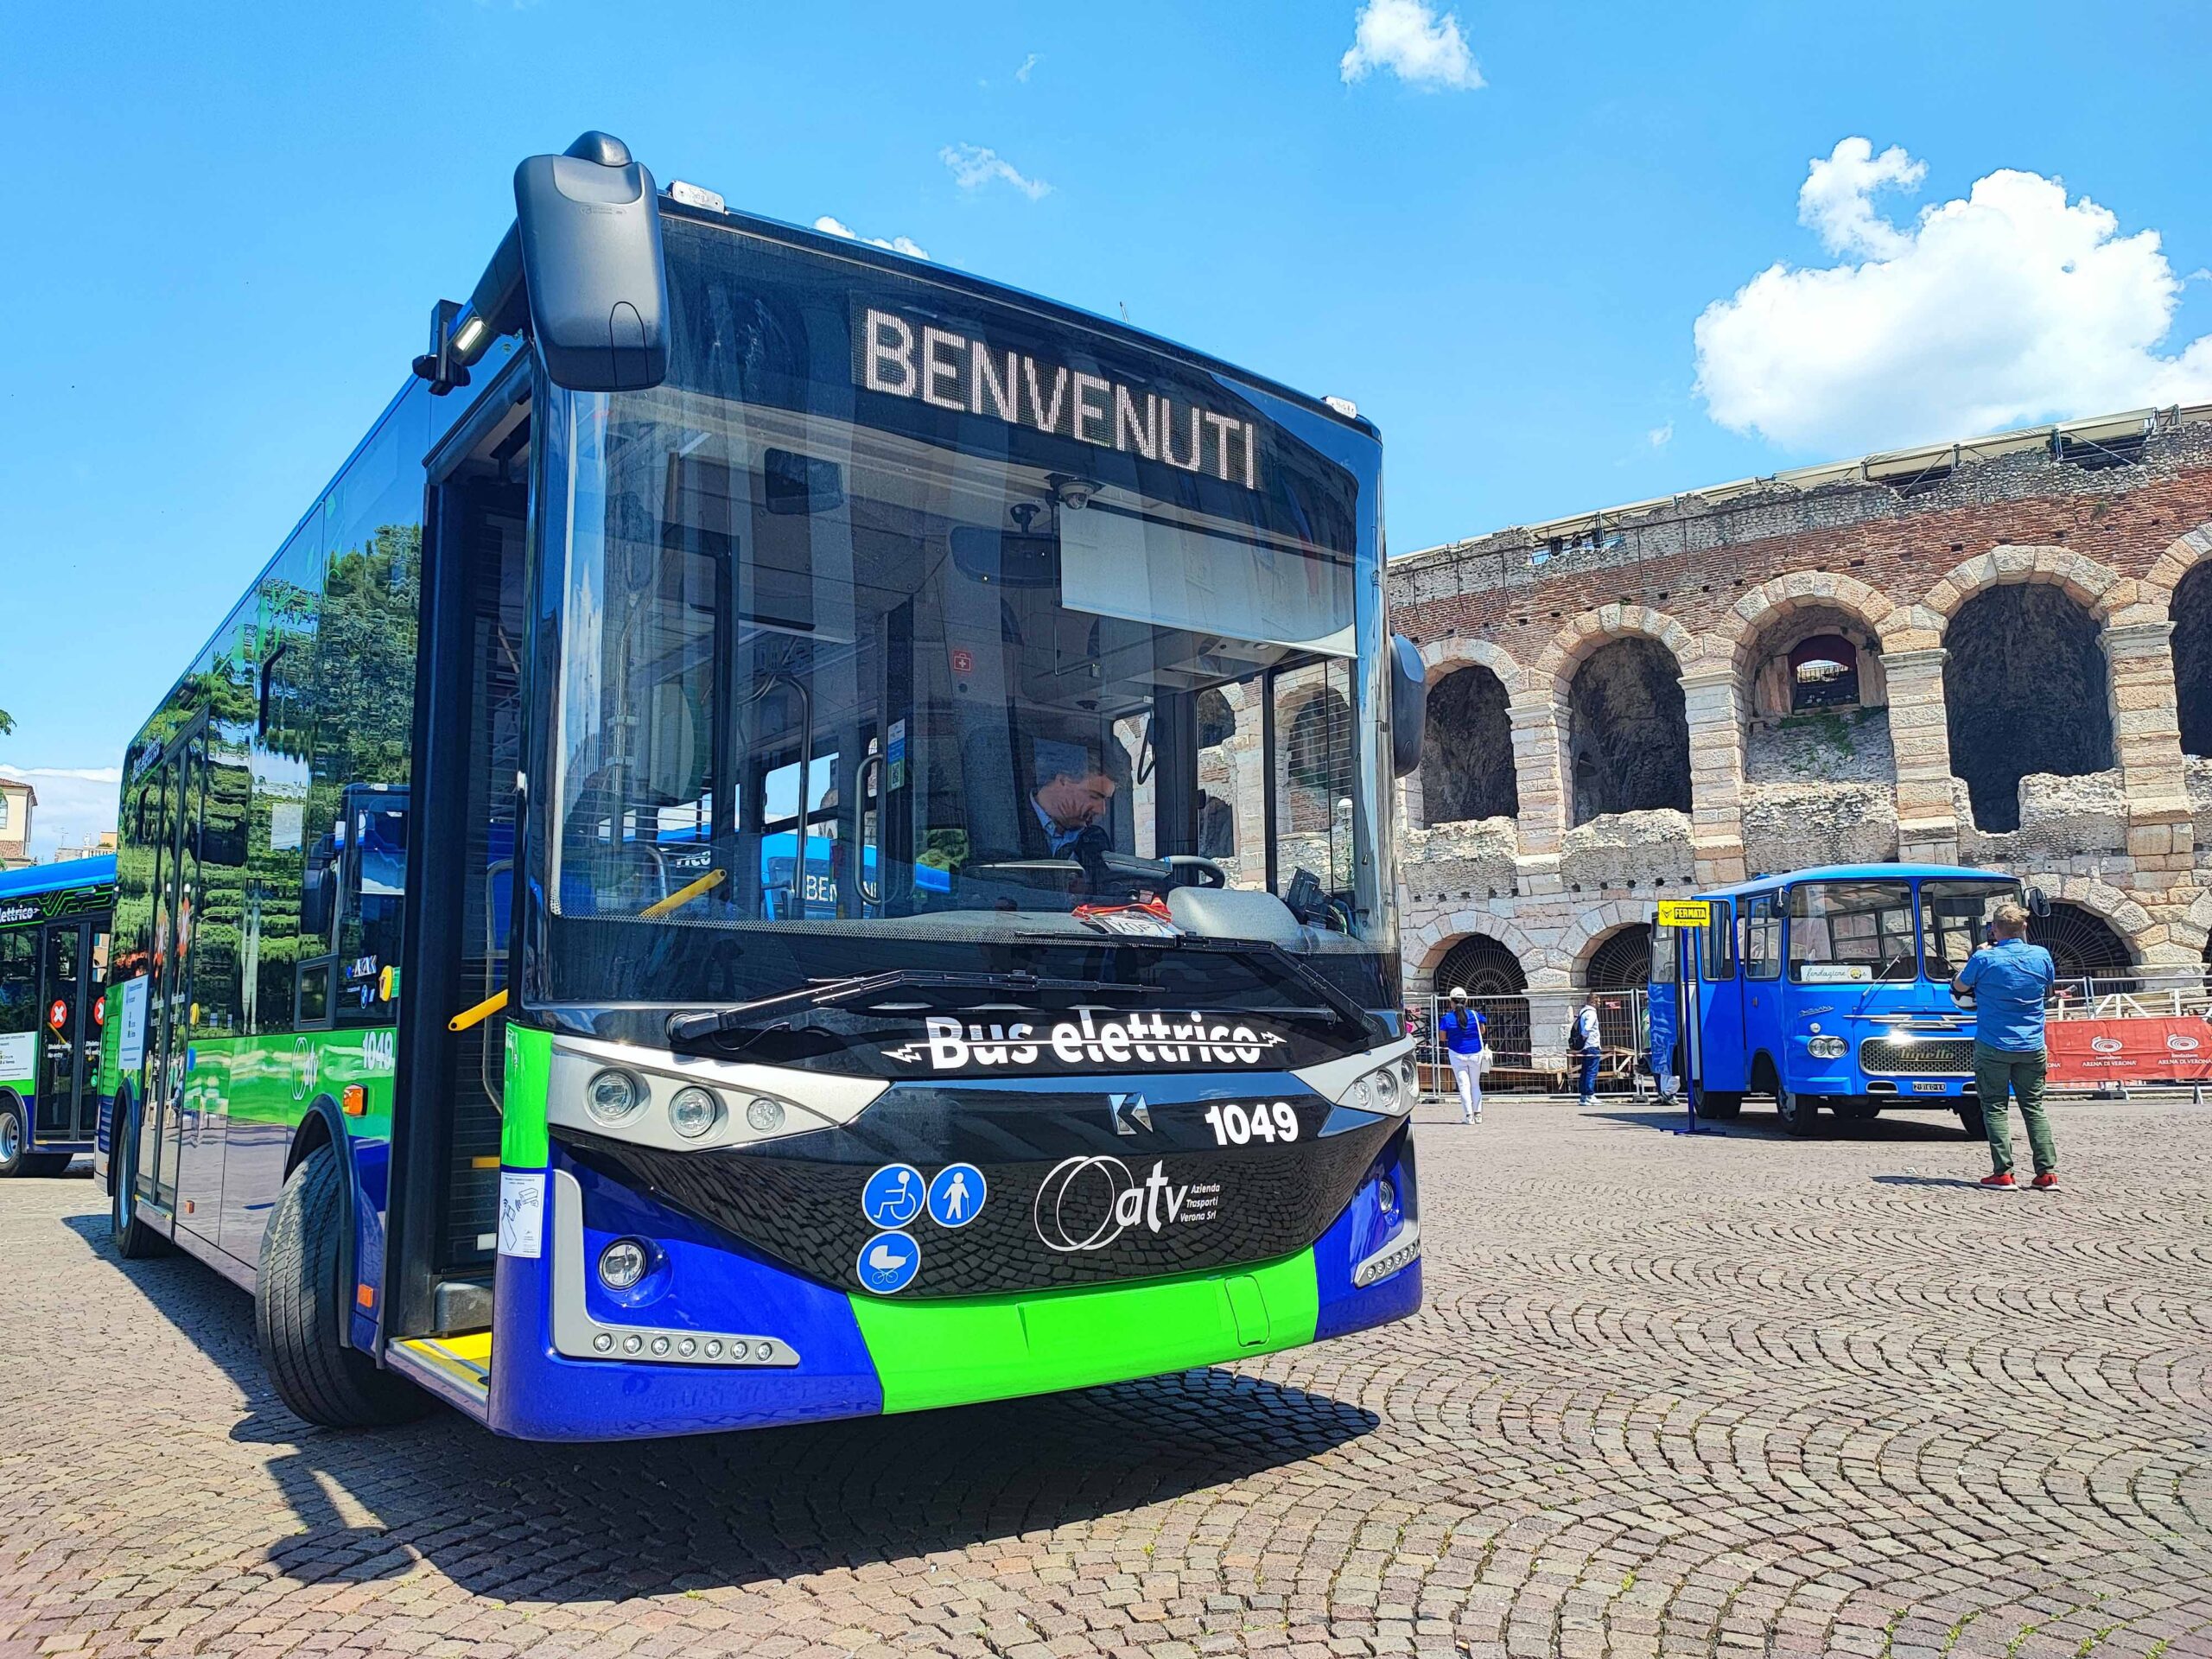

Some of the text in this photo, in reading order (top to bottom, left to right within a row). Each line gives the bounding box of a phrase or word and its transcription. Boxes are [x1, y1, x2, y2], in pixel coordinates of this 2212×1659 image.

[867, 308, 1255, 490] BENVENUTI
[1675, 908, 1706, 918] FERMATA
[925, 1009, 1261, 1070] Bus elettrico
[1205, 1102, 1299, 1146] 1049
[1115, 1160, 1188, 1234] atv
[1186, 1196, 1218, 1210] Trasporti
[1191, 1183, 1220, 1194] Azienda
[1180, 1210, 1217, 1223] Verona Srl
